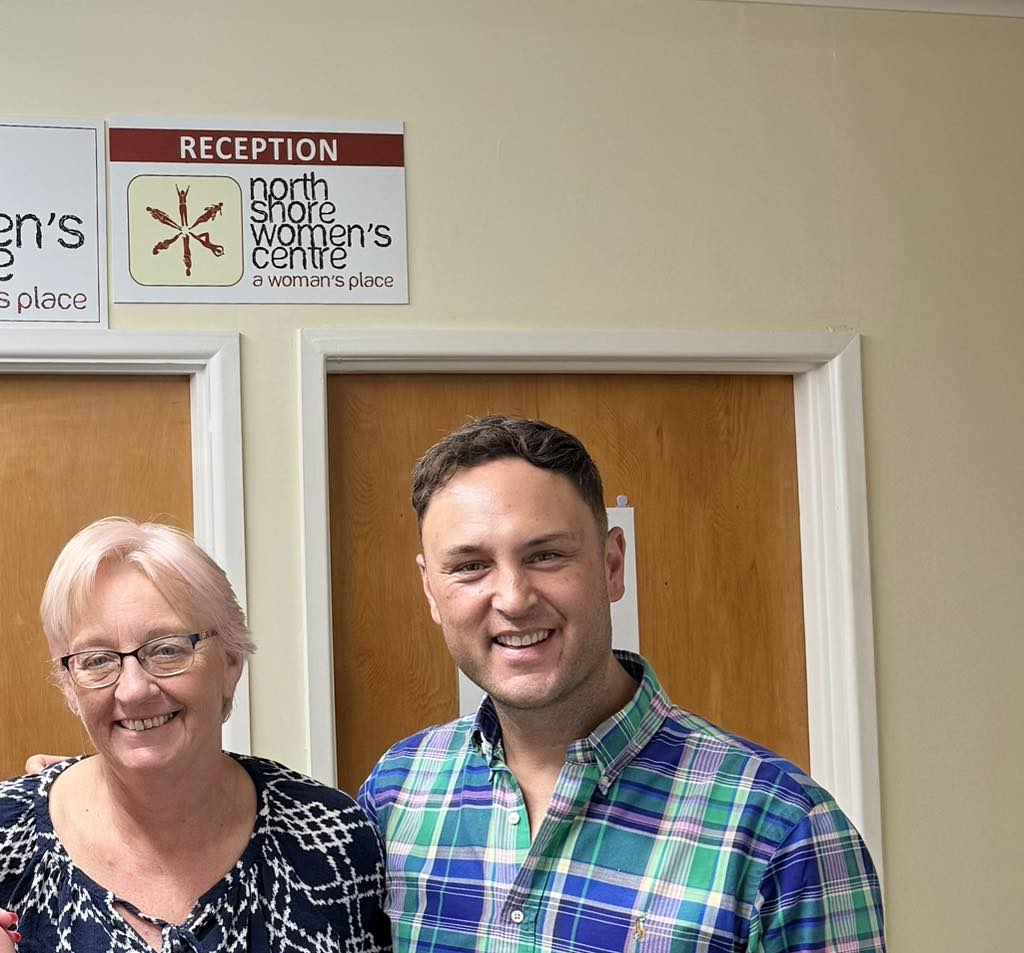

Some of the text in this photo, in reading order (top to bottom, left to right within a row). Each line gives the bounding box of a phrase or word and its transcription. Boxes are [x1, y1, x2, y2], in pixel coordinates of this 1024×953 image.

[180, 136, 338, 162] RECEPTION
[250, 171, 329, 201] north
[250, 194, 336, 224] shore
[250, 223, 393, 248] women's
[252, 246, 348, 270] centre
[252, 272, 394, 291] a woman's place
[17, 286, 88, 314] place
